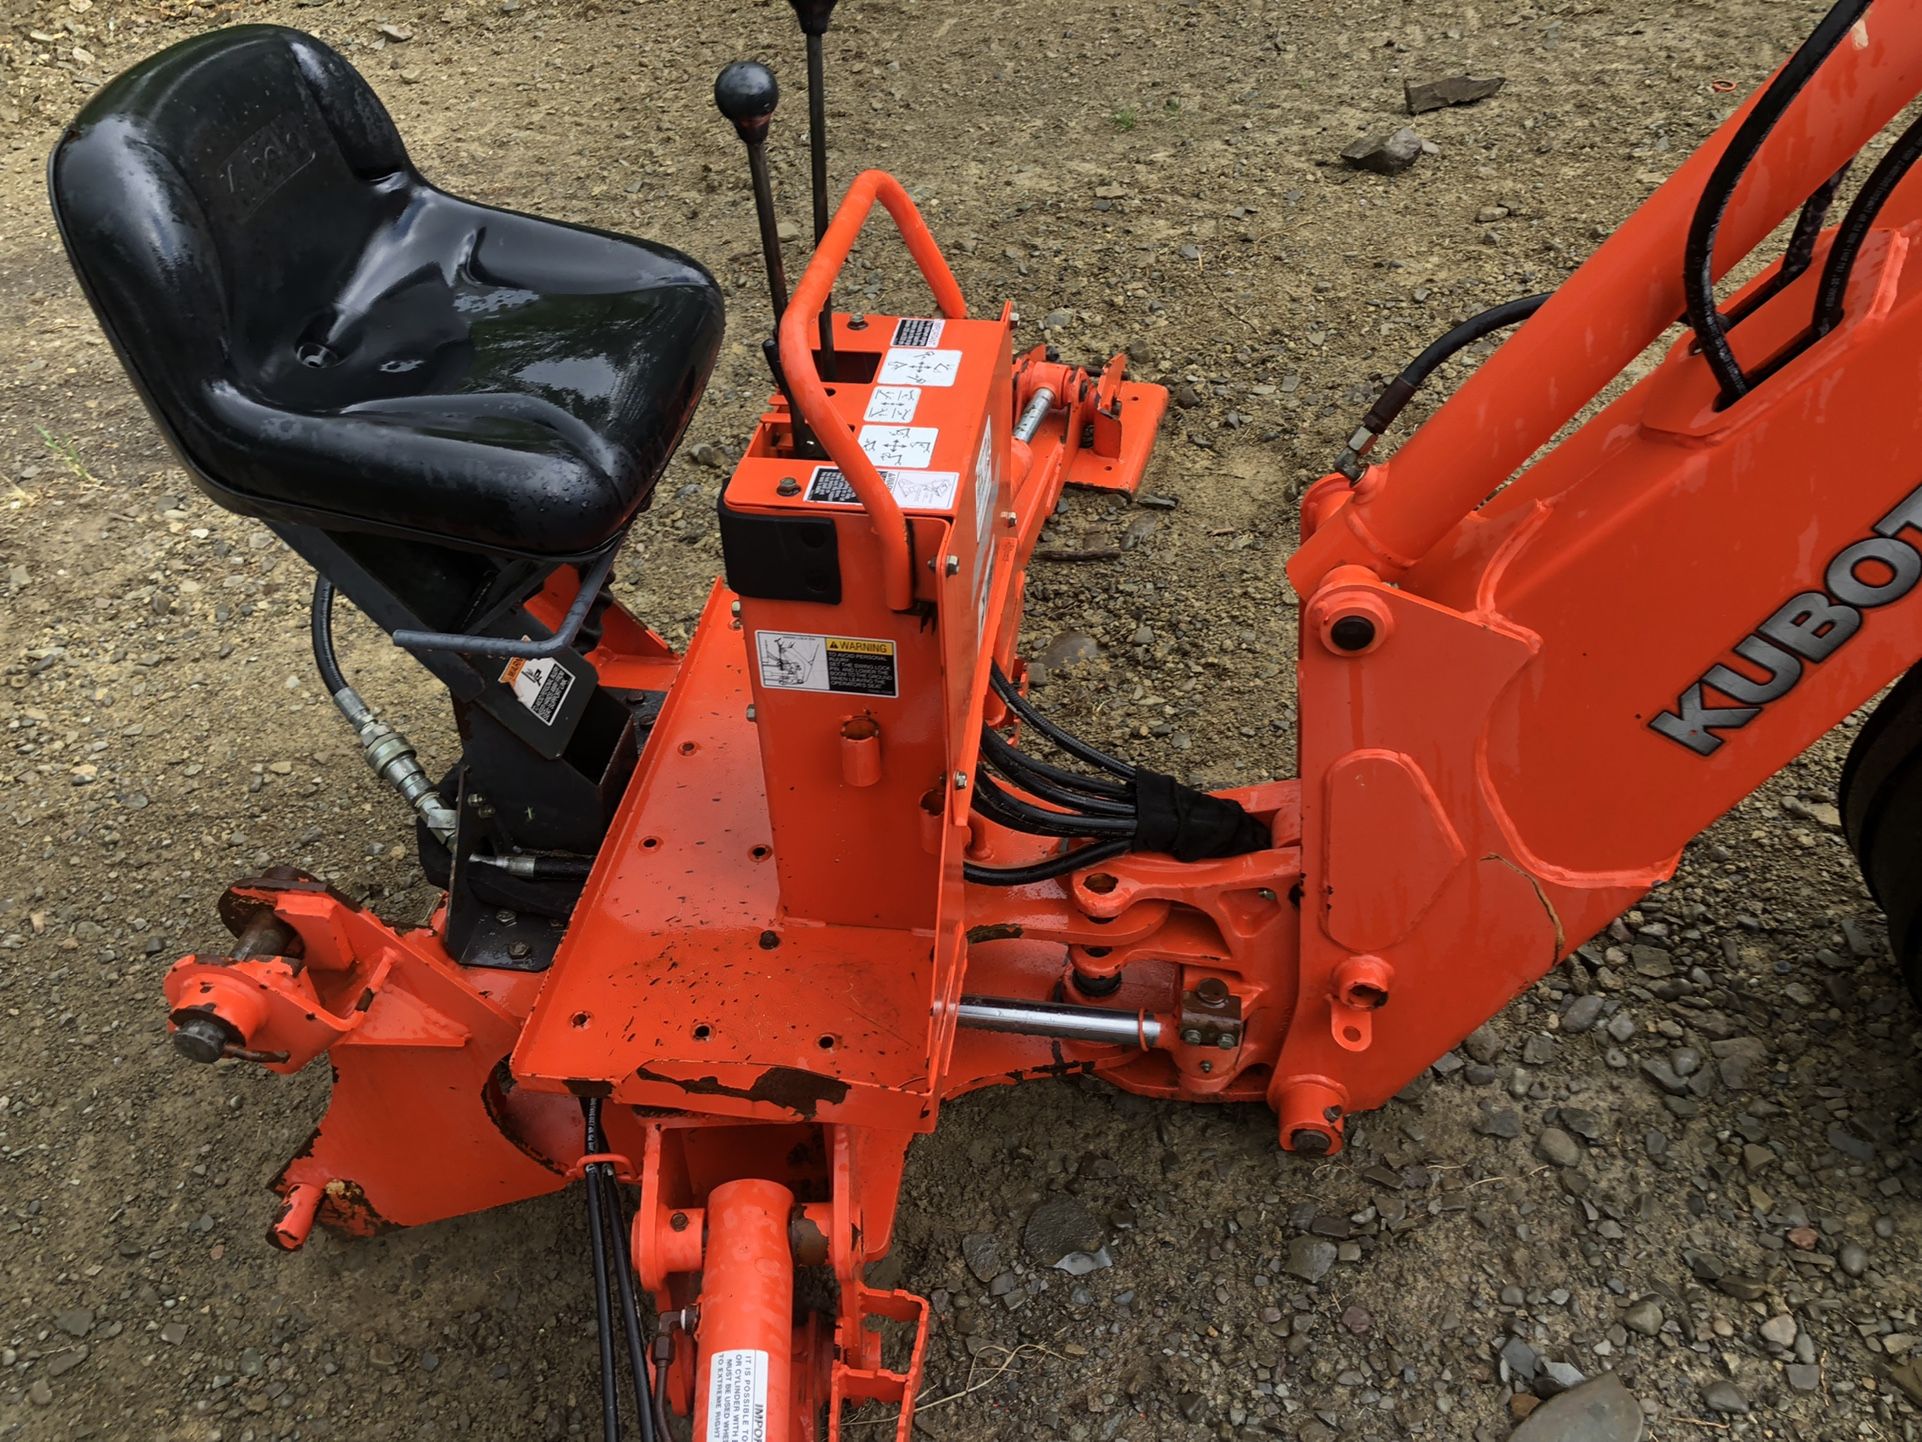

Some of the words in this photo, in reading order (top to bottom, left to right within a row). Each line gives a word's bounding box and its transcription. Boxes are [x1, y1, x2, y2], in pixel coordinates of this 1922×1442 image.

[840, 641, 887, 652] WARNING
[718, 1354, 724, 1365] TO
[735, 1354, 742, 1366] OR
[745, 1356, 751, 1364] IT
[745, 1368, 751, 1376] IS
[725, 1384, 731, 1394] BE
[733, 1369, 741, 1412] CYLINDER
[743, 1380, 751, 1425] POSSIBLE
